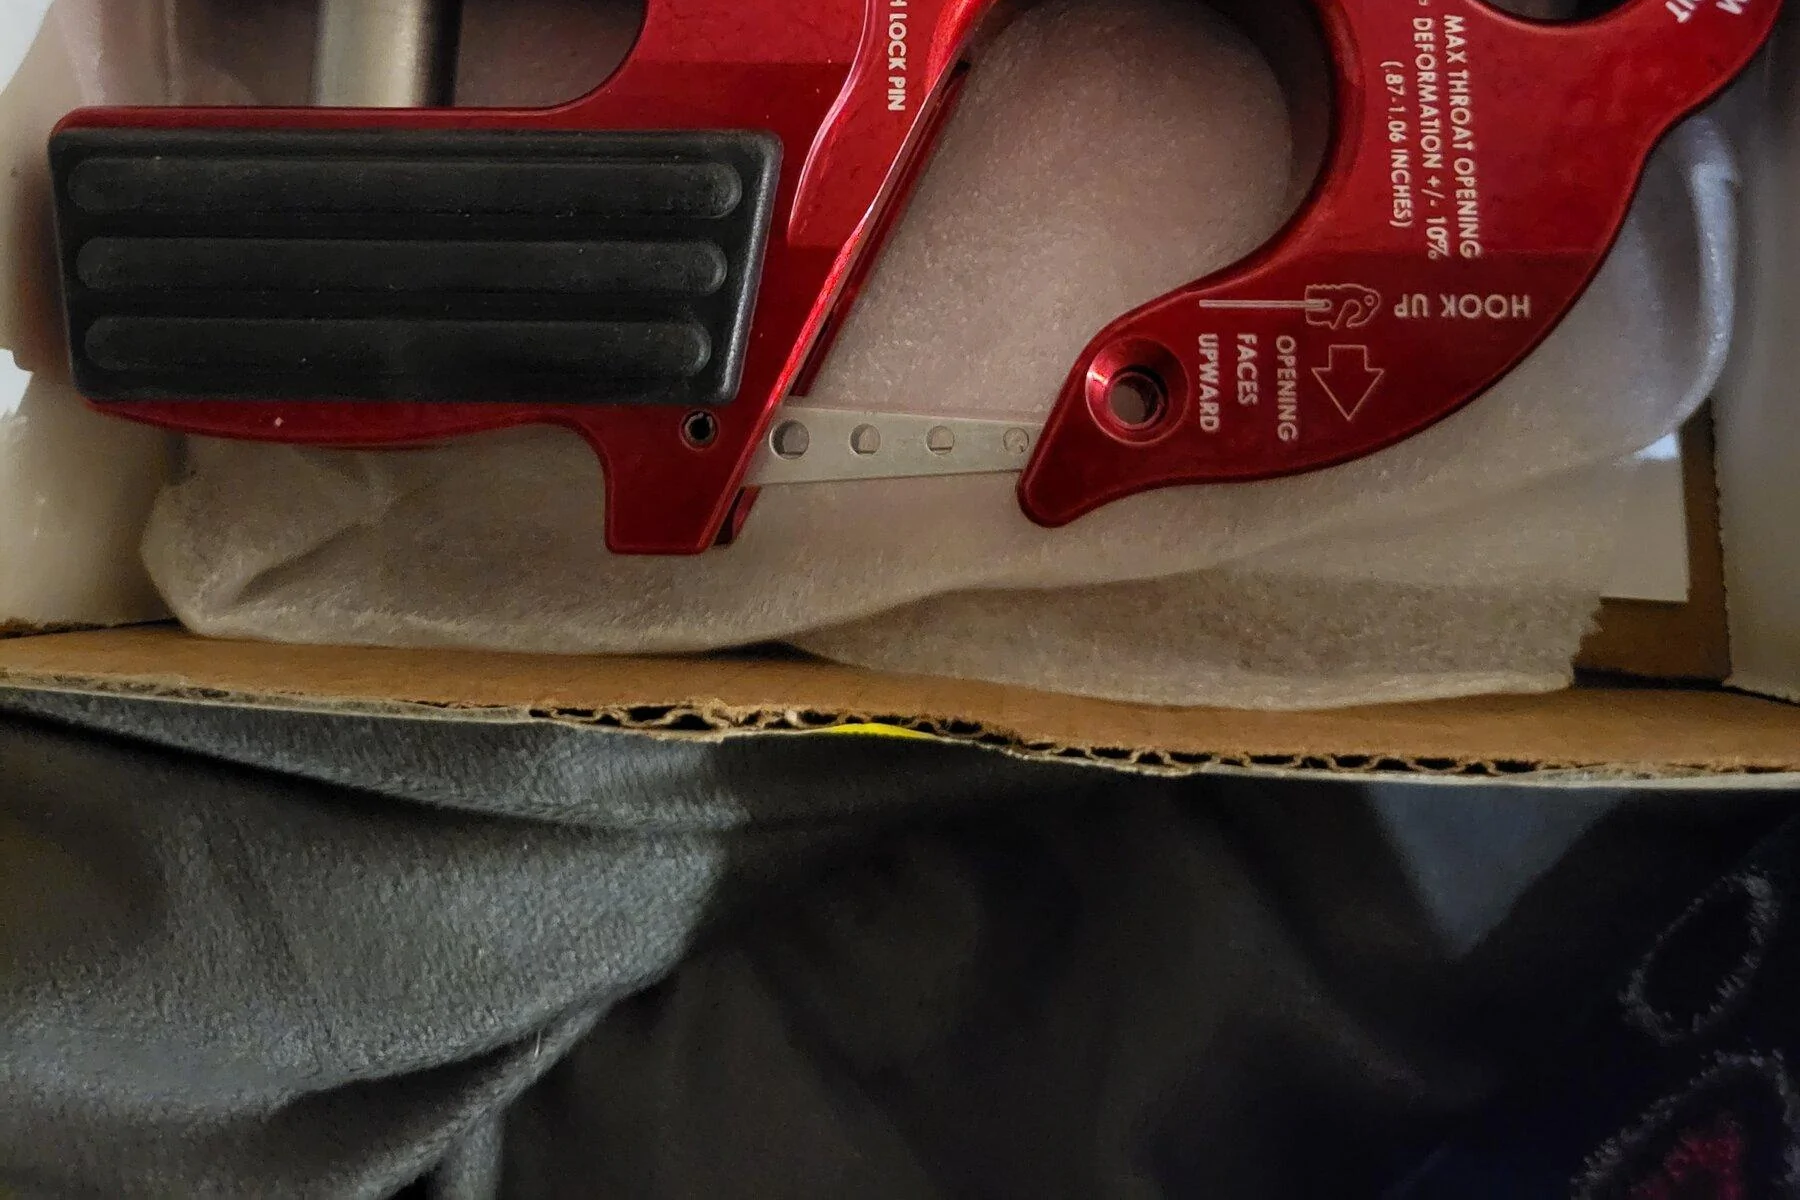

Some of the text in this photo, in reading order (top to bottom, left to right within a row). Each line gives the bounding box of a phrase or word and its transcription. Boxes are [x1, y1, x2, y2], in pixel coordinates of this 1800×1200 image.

[888, 13, 907, 71] LOCK
[887, 76, 906, 111] PIN
[1413, 17, 1443, 168] DEFORMATION
[1443, 14, 1481, 259] MAX THROAT OPENING
[1389, 149, 1413, 227] INCHES)
[1426, 216, 1449, 259] 10%
[1394, 293, 1531, 318] HOOK UP
[1197, 333, 1220, 433] UPWARD
[1236, 333, 1258, 405] FACES
[1276, 334, 1298, 441] OPENING
